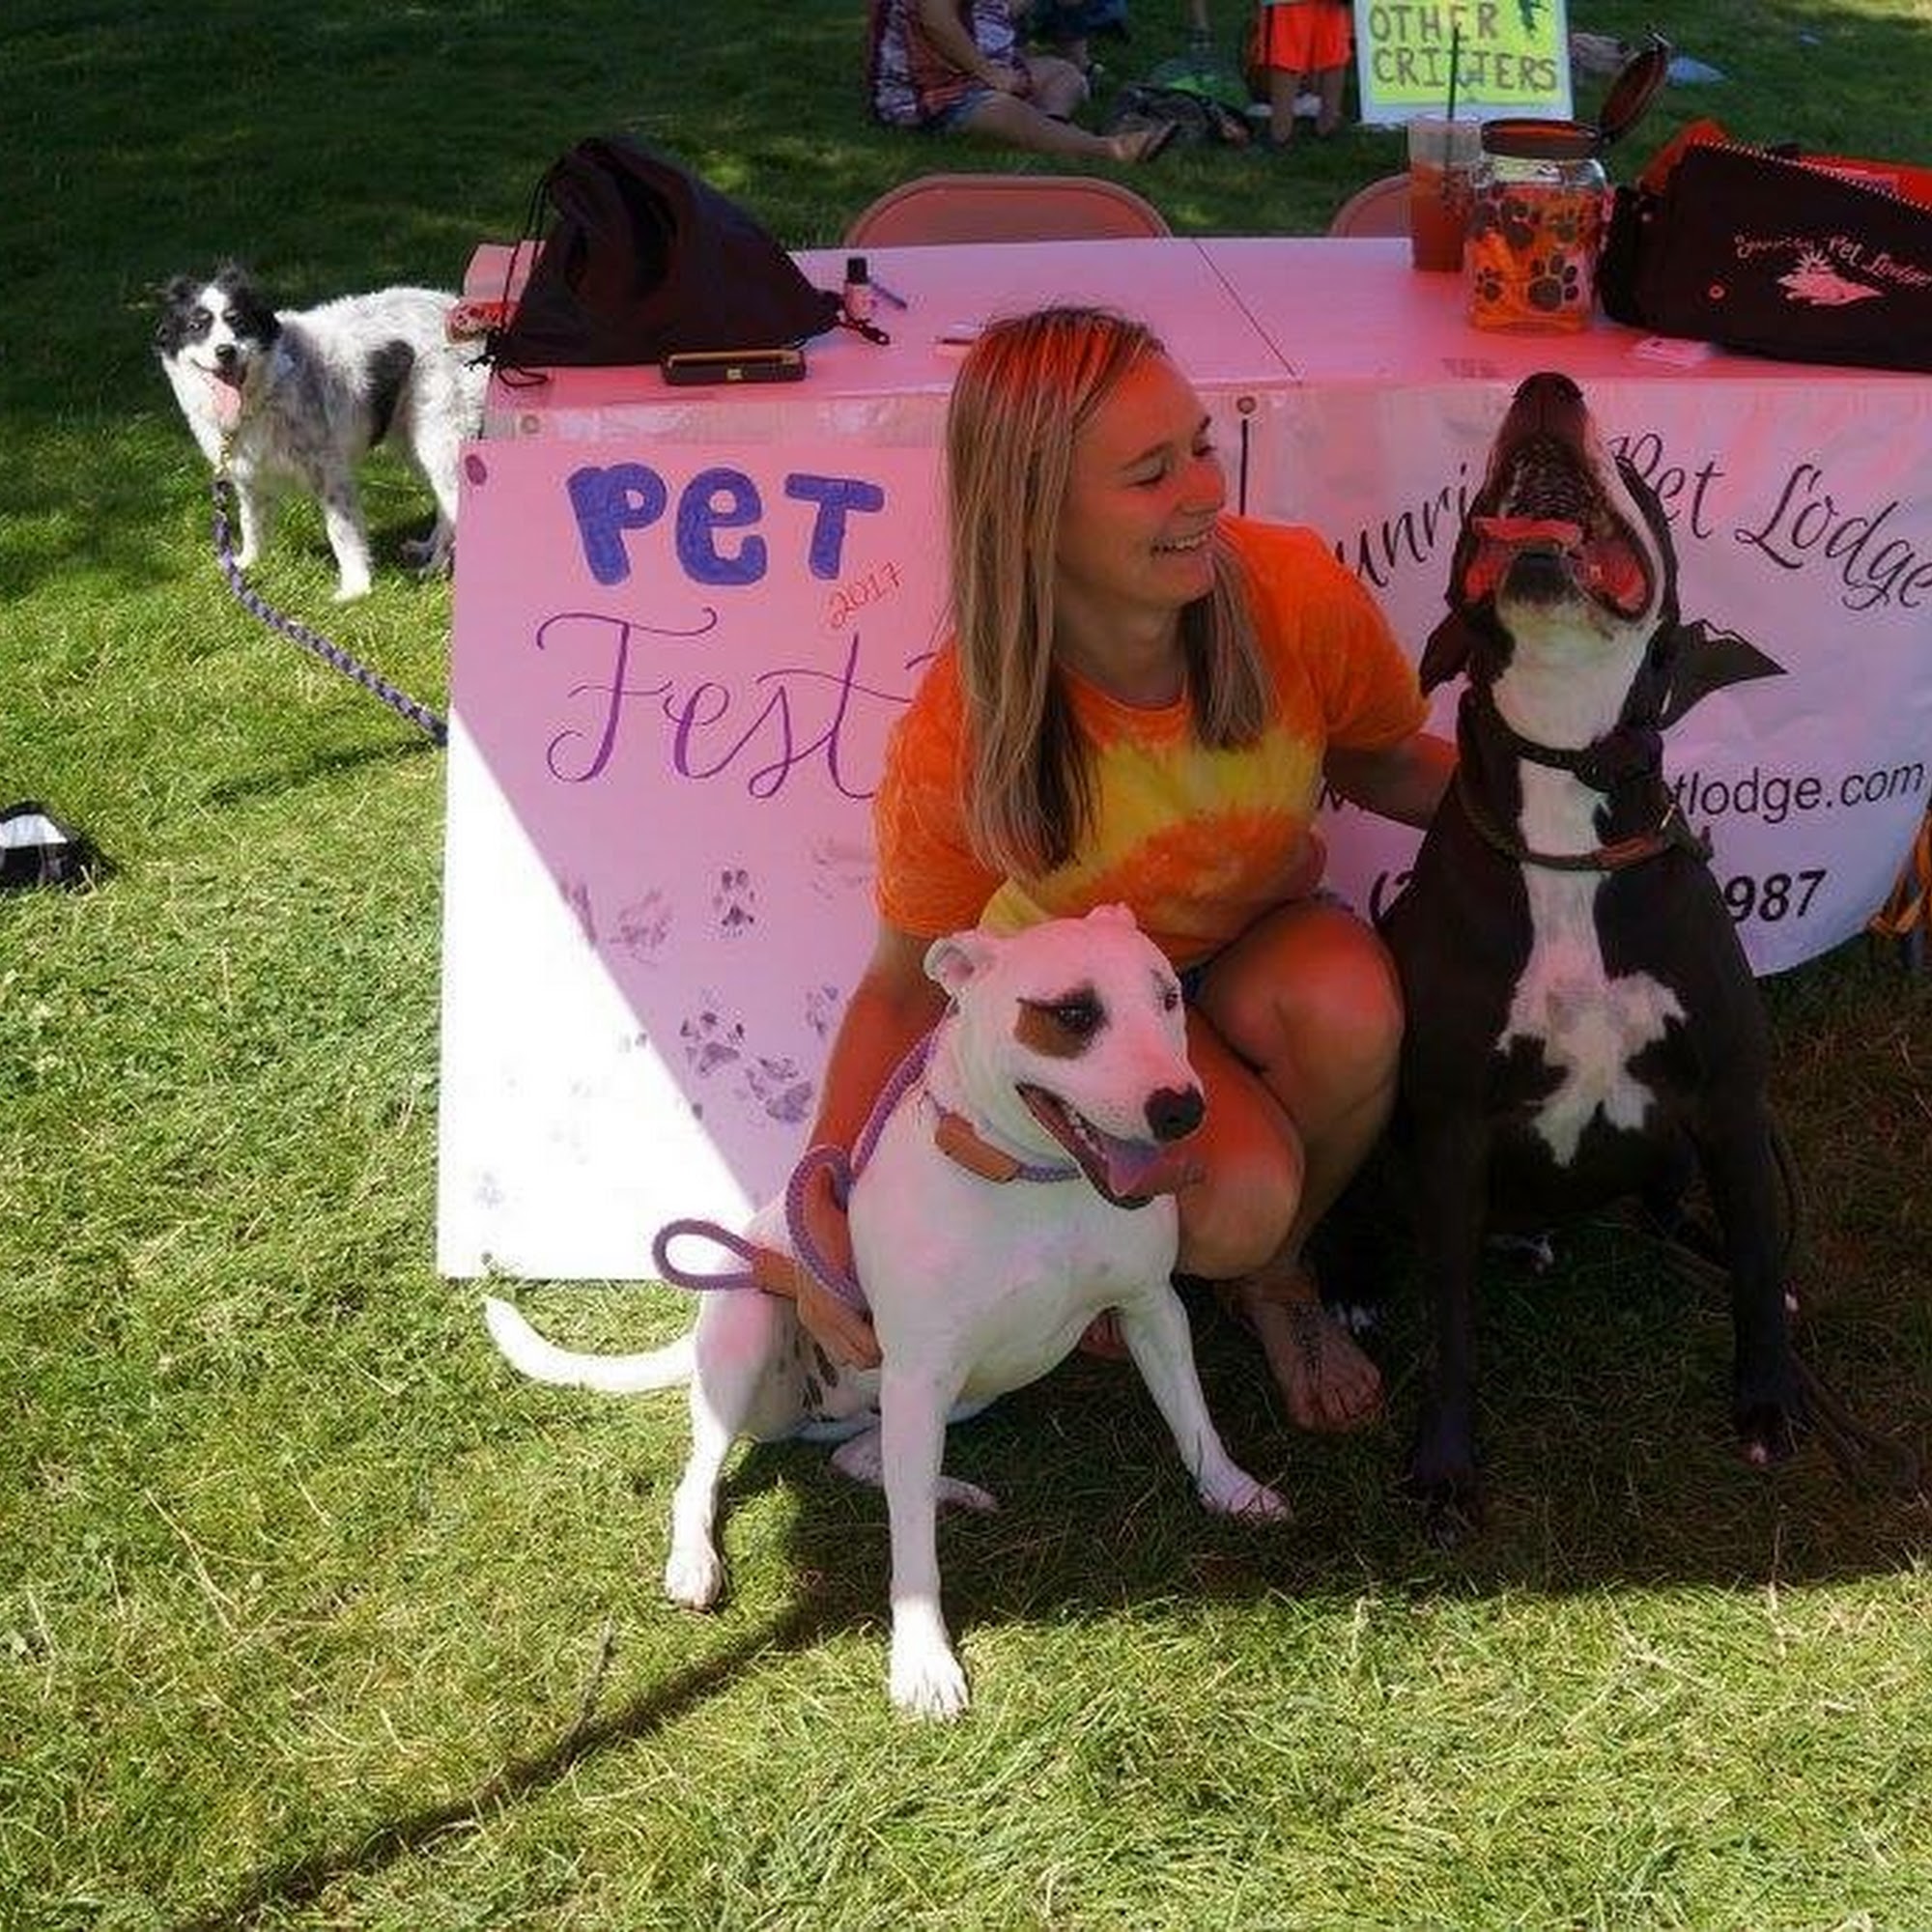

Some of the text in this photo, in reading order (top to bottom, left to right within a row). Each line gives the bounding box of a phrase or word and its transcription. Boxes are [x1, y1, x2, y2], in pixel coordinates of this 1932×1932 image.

[1368, 2, 1498, 43] OTHER
[1828, 235, 1863, 267] Pet
[1335, 433, 1932, 611] unri Pet Lodge
[830, 560, 904, 630] 2017
[536, 607, 914, 799] Fest
[1675, 762, 1925, 824] tlodge.com
[1724, 869, 1828, 922] 987
